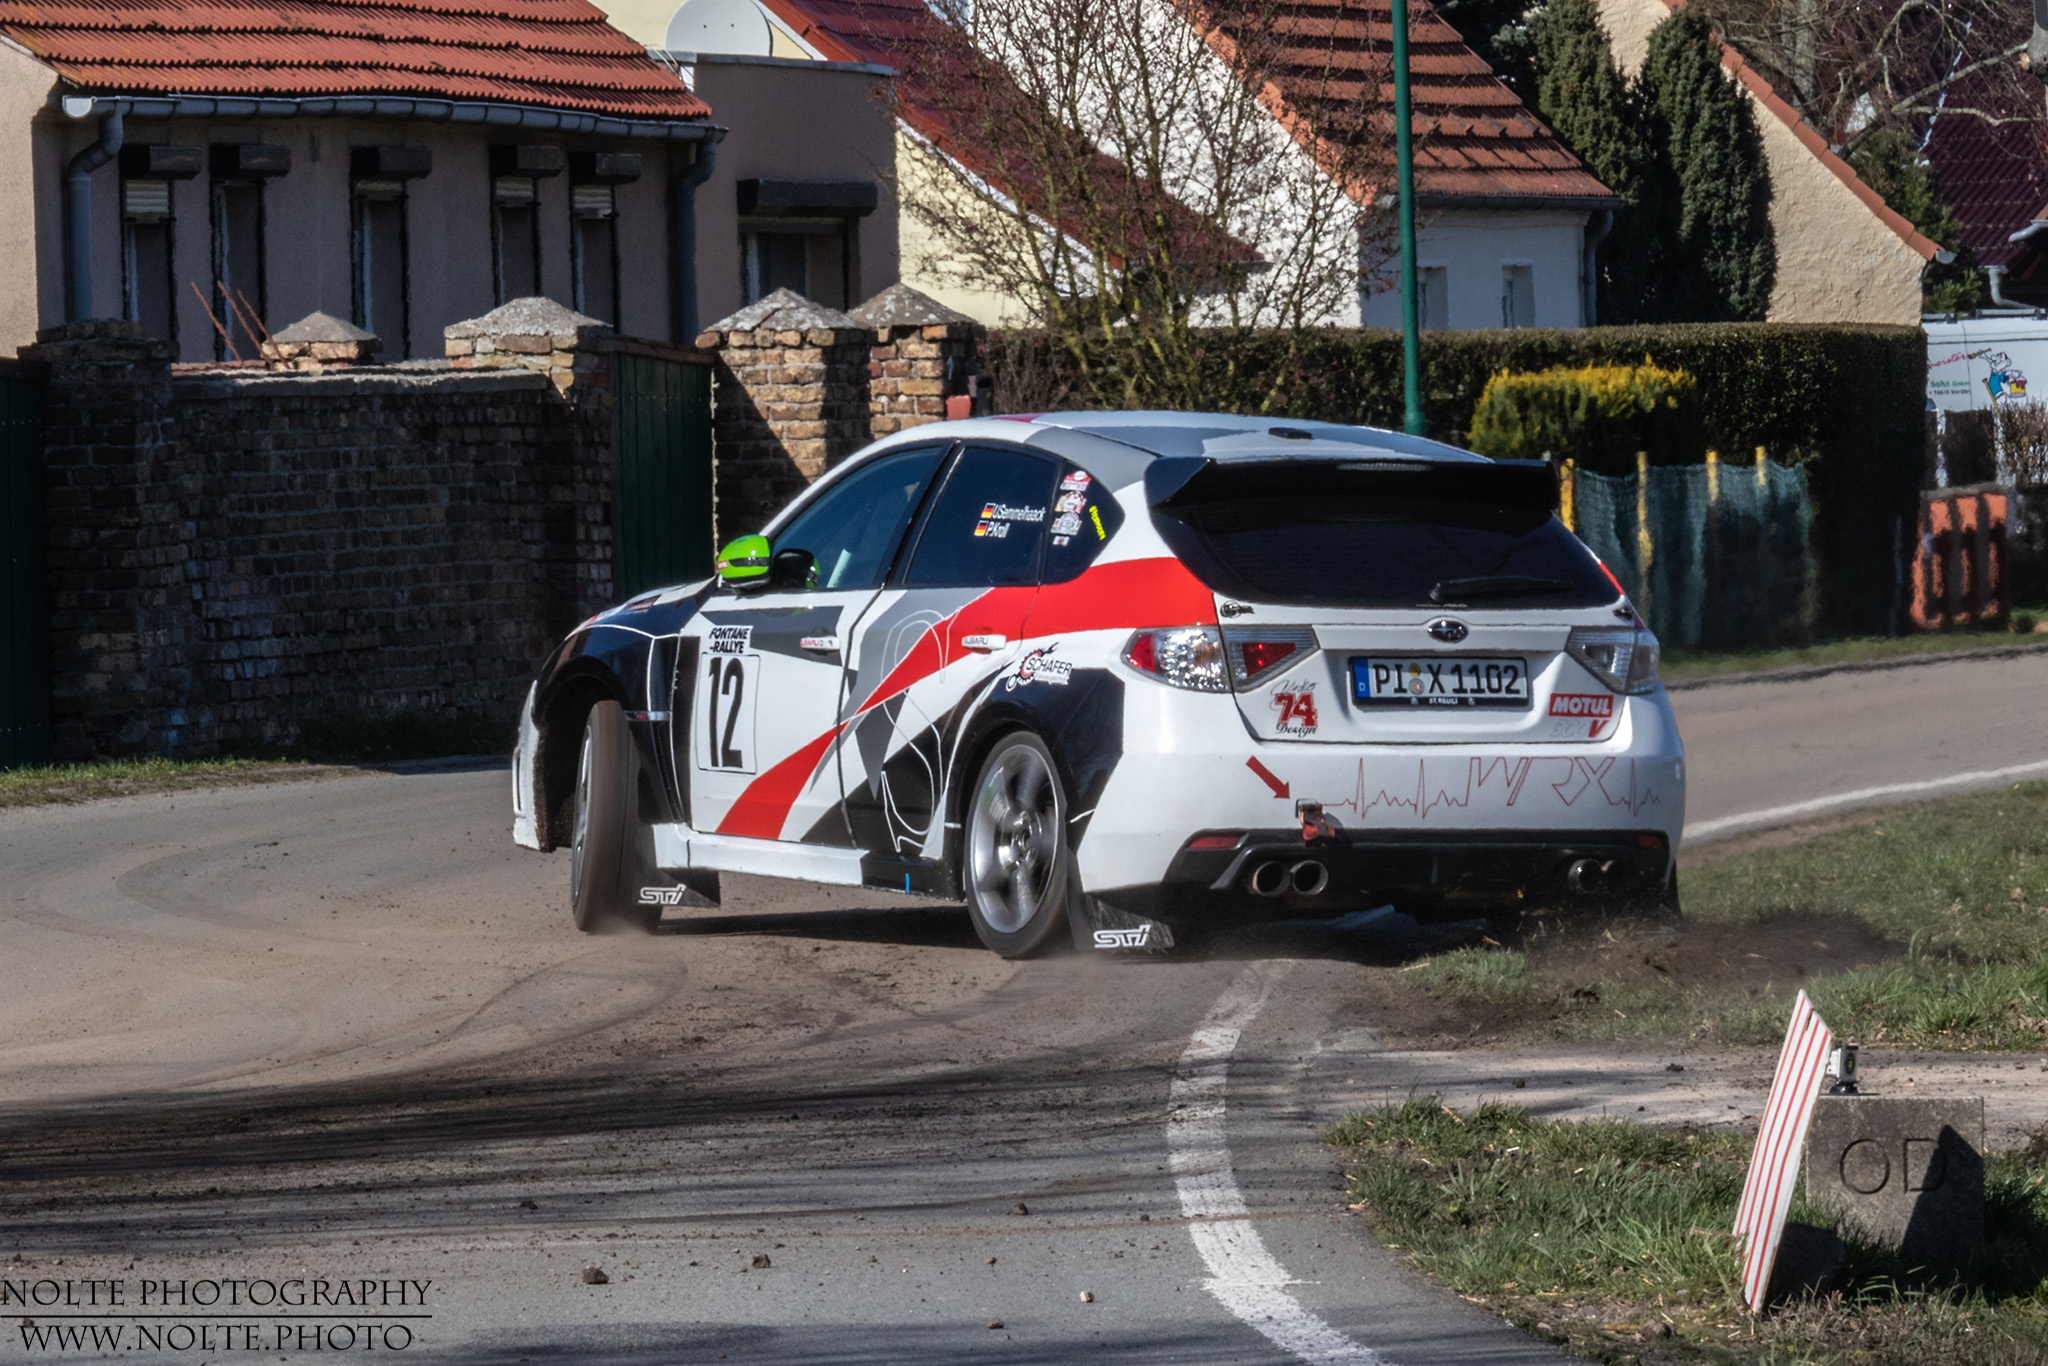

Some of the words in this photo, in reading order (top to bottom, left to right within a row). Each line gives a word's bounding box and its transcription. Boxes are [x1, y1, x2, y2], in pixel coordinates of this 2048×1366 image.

[709, 627, 750, 640] FONTANE
[1358, 682, 1366, 692] D
[1372, 664, 1408, 694] PI
[708, 656, 743, 768] 12
[1275, 692, 1318, 728] 74
[1551, 696, 1610, 714] MOTUL
[1275, 721, 1317, 738] Design
[1465, 756, 1616, 807] WRX
